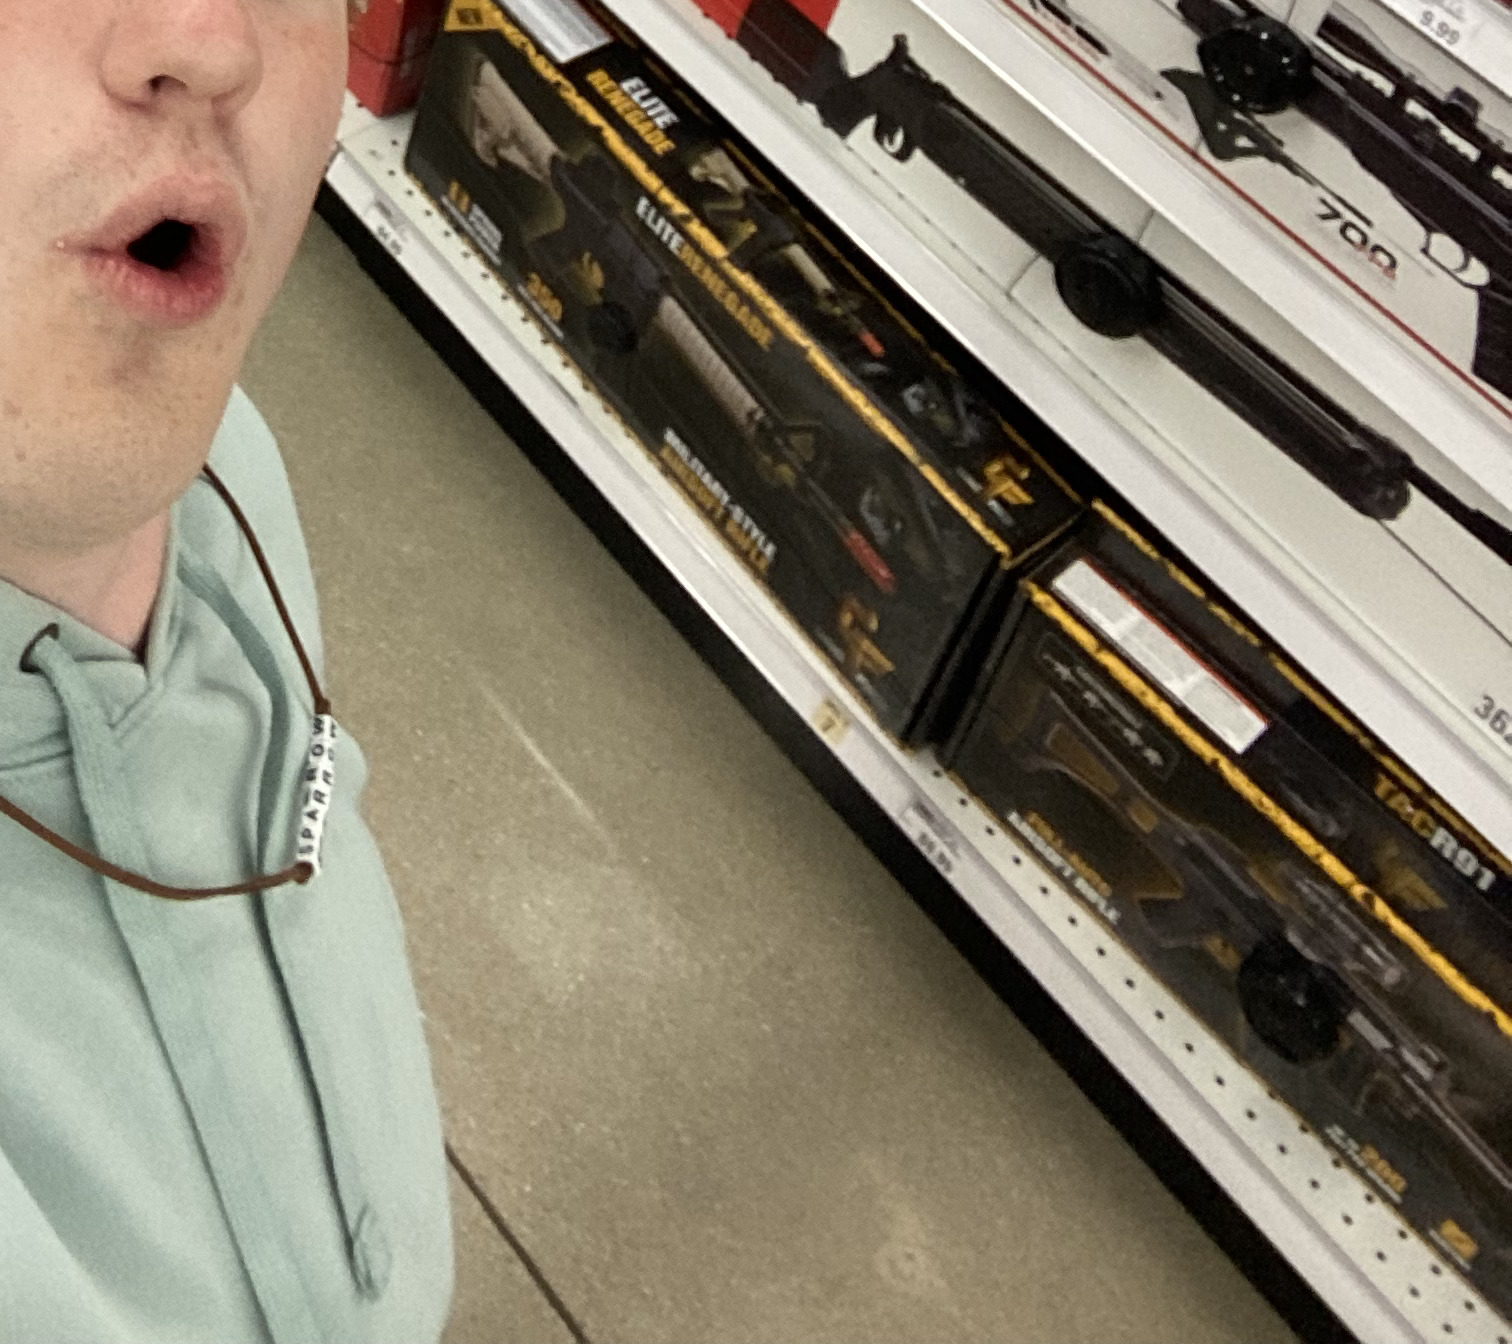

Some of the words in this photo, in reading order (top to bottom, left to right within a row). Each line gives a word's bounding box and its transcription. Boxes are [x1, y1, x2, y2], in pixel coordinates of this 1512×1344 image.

[1419, 9, 1462, 46] 9.99
[585, 67, 678, 157] RENEGADE
[619, 75, 681, 130] ELITE
[635, 195, 685, 255] ELITE
[678, 237, 776, 351] RENEGADE
[1314, 196, 1399, 276] 700
[662, 426, 778, 562] MILITARY-STYLE
